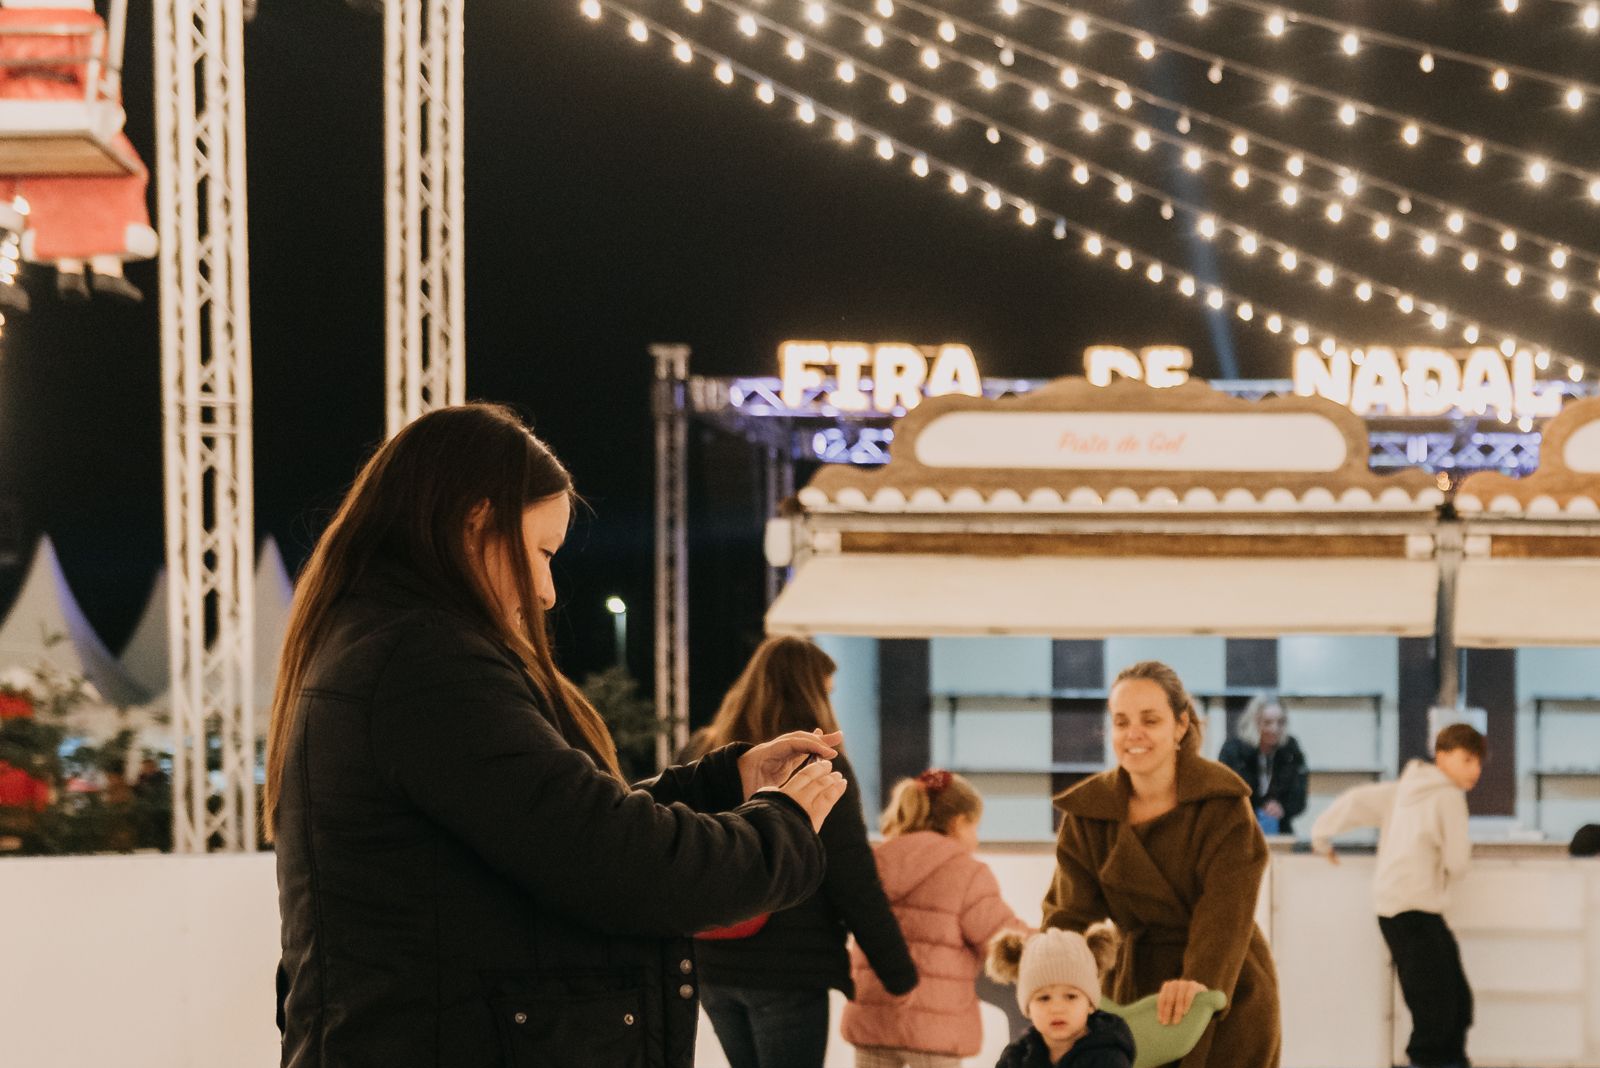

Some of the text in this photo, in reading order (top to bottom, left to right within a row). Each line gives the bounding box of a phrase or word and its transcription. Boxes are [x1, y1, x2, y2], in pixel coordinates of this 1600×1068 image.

[778, 340, 1562, 416] FIRA DE NADAL
